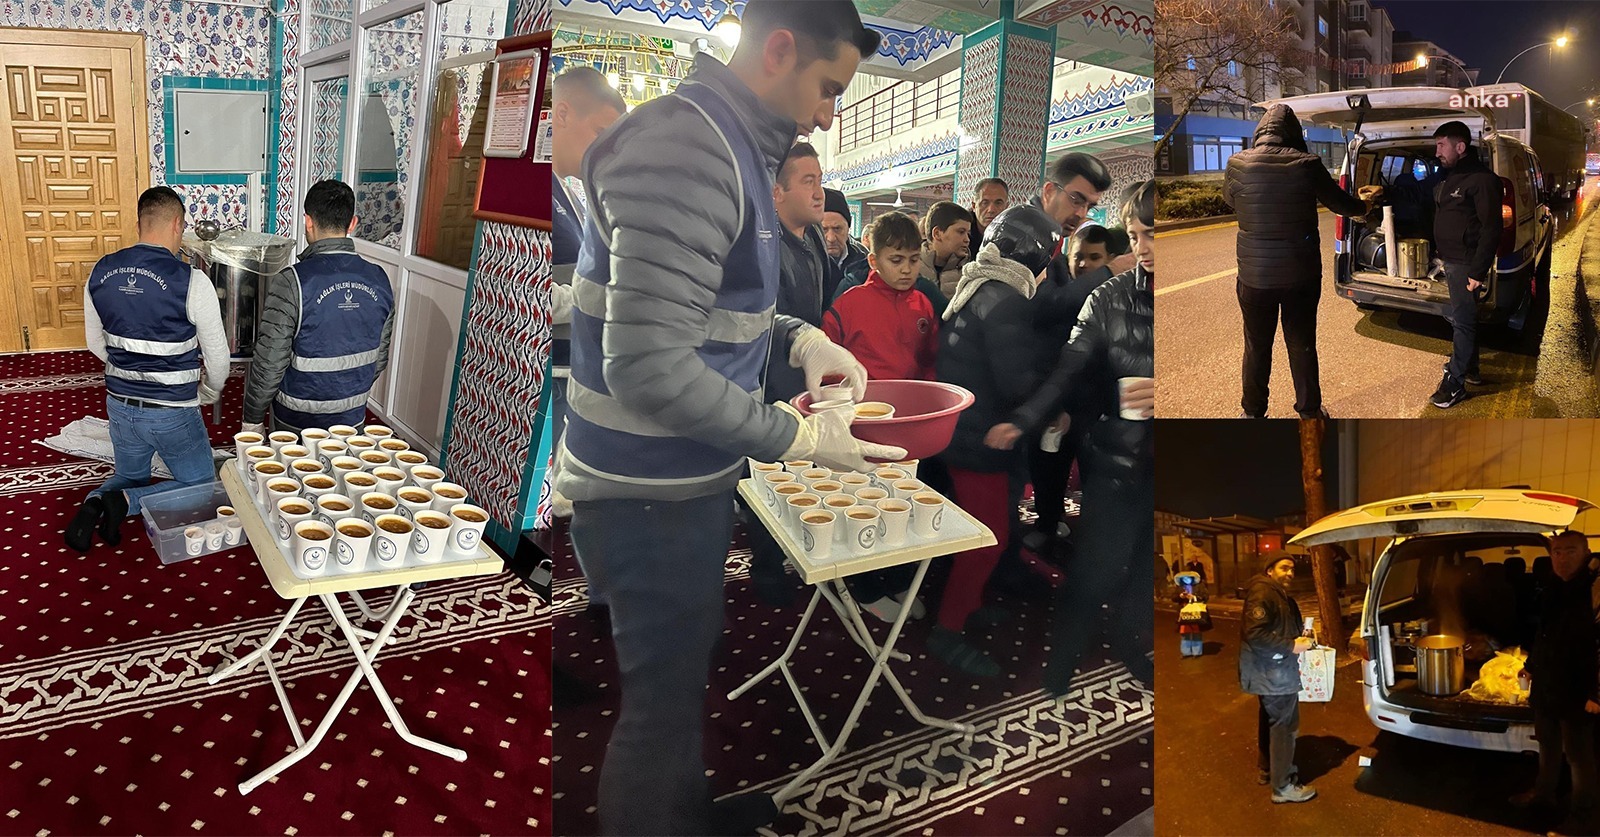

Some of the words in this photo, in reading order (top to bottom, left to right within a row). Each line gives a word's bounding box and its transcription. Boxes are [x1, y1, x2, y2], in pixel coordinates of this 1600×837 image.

[100, 268, 119, 284] SAĞLIK
[119, 266, 136, 274] İŞLERİ
[136, 267, 168, 291] MÜDÜRLÜĞÜ
[316, 285, 335, 305] SAĞLIK
[334, 281, 351, 291] İŞLERİ
[350, 281, 378, 302] MÜDÜRLÜĞÜ
